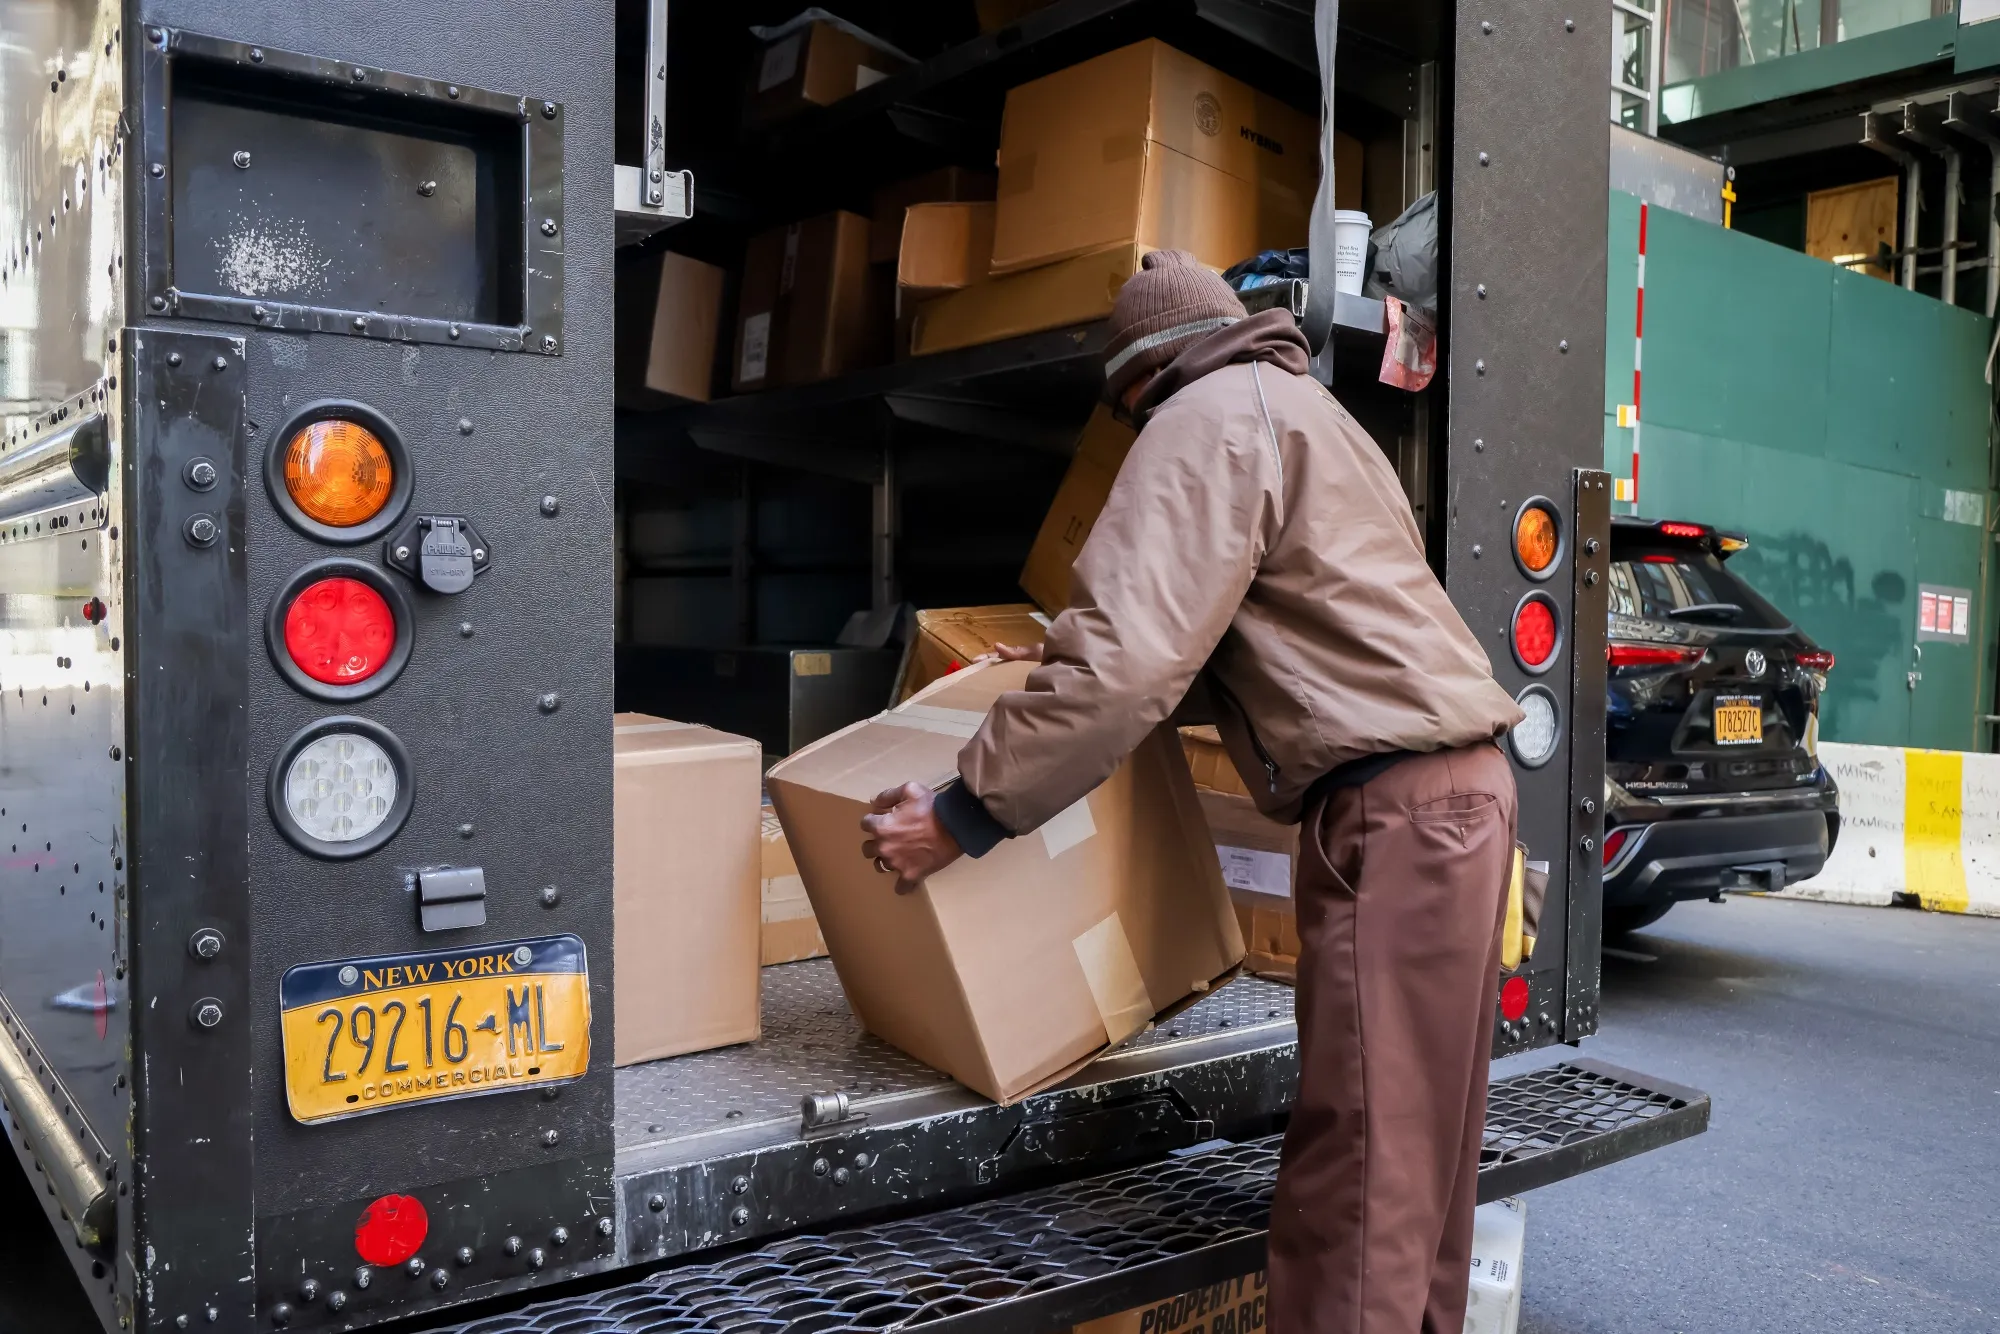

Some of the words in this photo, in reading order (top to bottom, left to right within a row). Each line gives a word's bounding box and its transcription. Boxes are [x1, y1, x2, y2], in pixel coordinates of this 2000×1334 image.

[1240, 126, 1284, 155] HYBRID
[1718, 710, 1758, 733] T782527C
[362, 962, 435, 991] NEW
[442, 951, 515, 979] YORK
[361, 1063, 525, 1100] COMMERCIAL
[1139, 1275, 1246, 1334] PROPERTY
[1212, 1294, 1268, 1334] PARC
